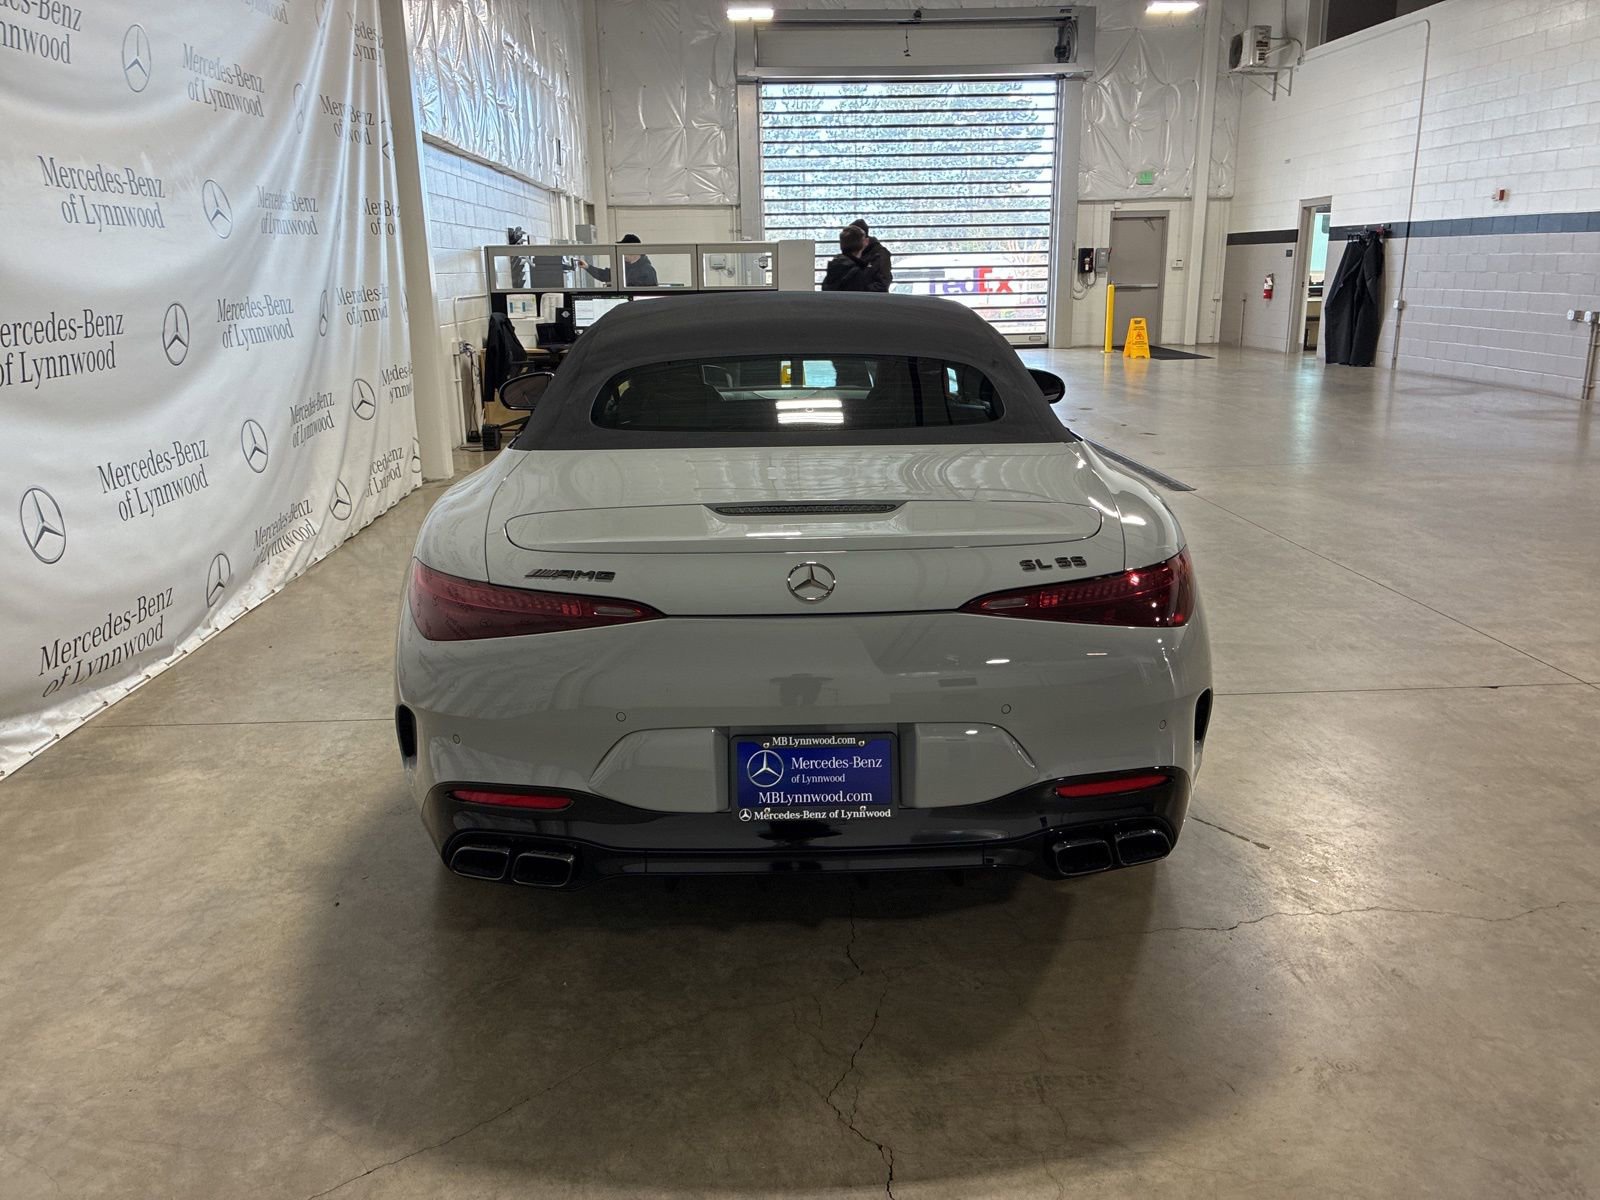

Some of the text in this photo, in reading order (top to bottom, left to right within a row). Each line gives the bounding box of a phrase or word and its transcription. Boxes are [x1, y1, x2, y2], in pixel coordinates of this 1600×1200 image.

[183, 43, 264, 93] Mercedes-Benz
[187, 77, 264, 117] of Lynnwood
[38, 155, 166, 198] Mercedes-Benz
[61, 193, 166, 232] of Lynnwood
[0, 308, 124, 348] ercedes-Benz
[217, 294, 294, 323] Mercedes-Benz
[222, 317, 294, 351] of Lynnwood
[18, 340, 116, 390] Lynnwood
[97, 440, 209, 494] Mercedes-Benz
[118, 463, 209, 521] of Lynnwood
[1019, 559, 1052, 571] SL
[38, 587, 174, 677] Mercedes-Benz
[42, 614, 164, 698] of Lynnwood
[791, 756, 882, 770] Mercedes-Benz
[791, 773, 845, 785] of Lynnwood
[754, 809, 891, 820] Mercedes-Benz of Lynnwood
[758, 790, 873, 806] MBLynnwood.com
